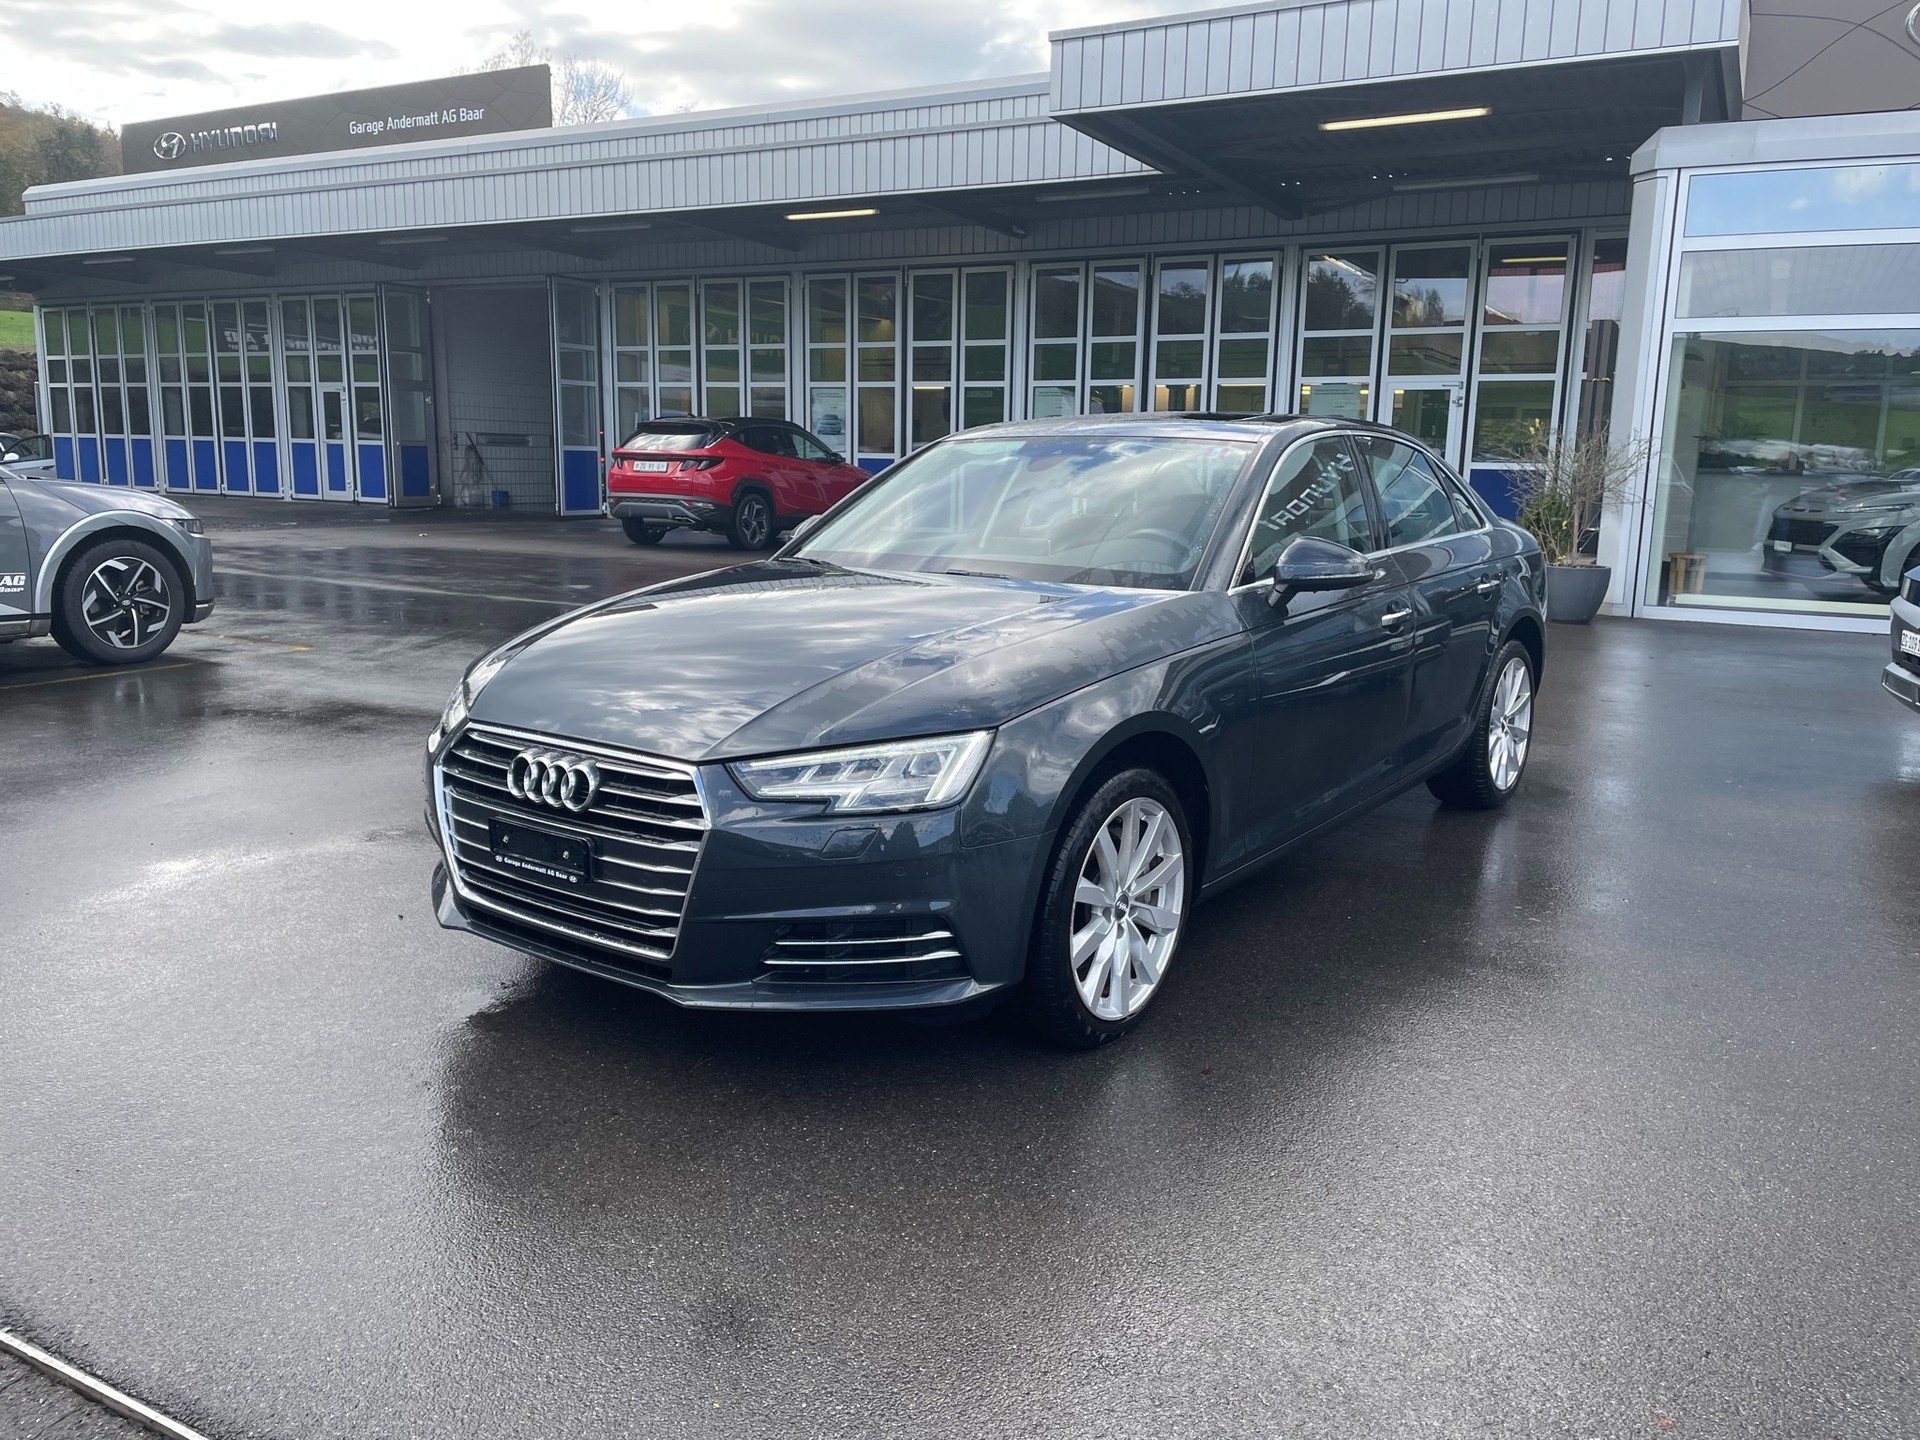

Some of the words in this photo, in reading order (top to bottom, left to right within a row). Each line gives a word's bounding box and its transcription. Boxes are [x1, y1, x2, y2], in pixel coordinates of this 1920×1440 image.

[349, 120, 384, 135] Garage
[386, 111, 439, 131] Andermatt
[441, 108, 457, 124] AG
[459, 107, 485, 122] Baar
[190, 121, 278, 152] HYUNDAI
[0, 575, 25, 586] AG
[504, 857, 521, 867] Garage
[521, 862, 547, 874] Andermatt
[555, 871, 567, 880] Baar
